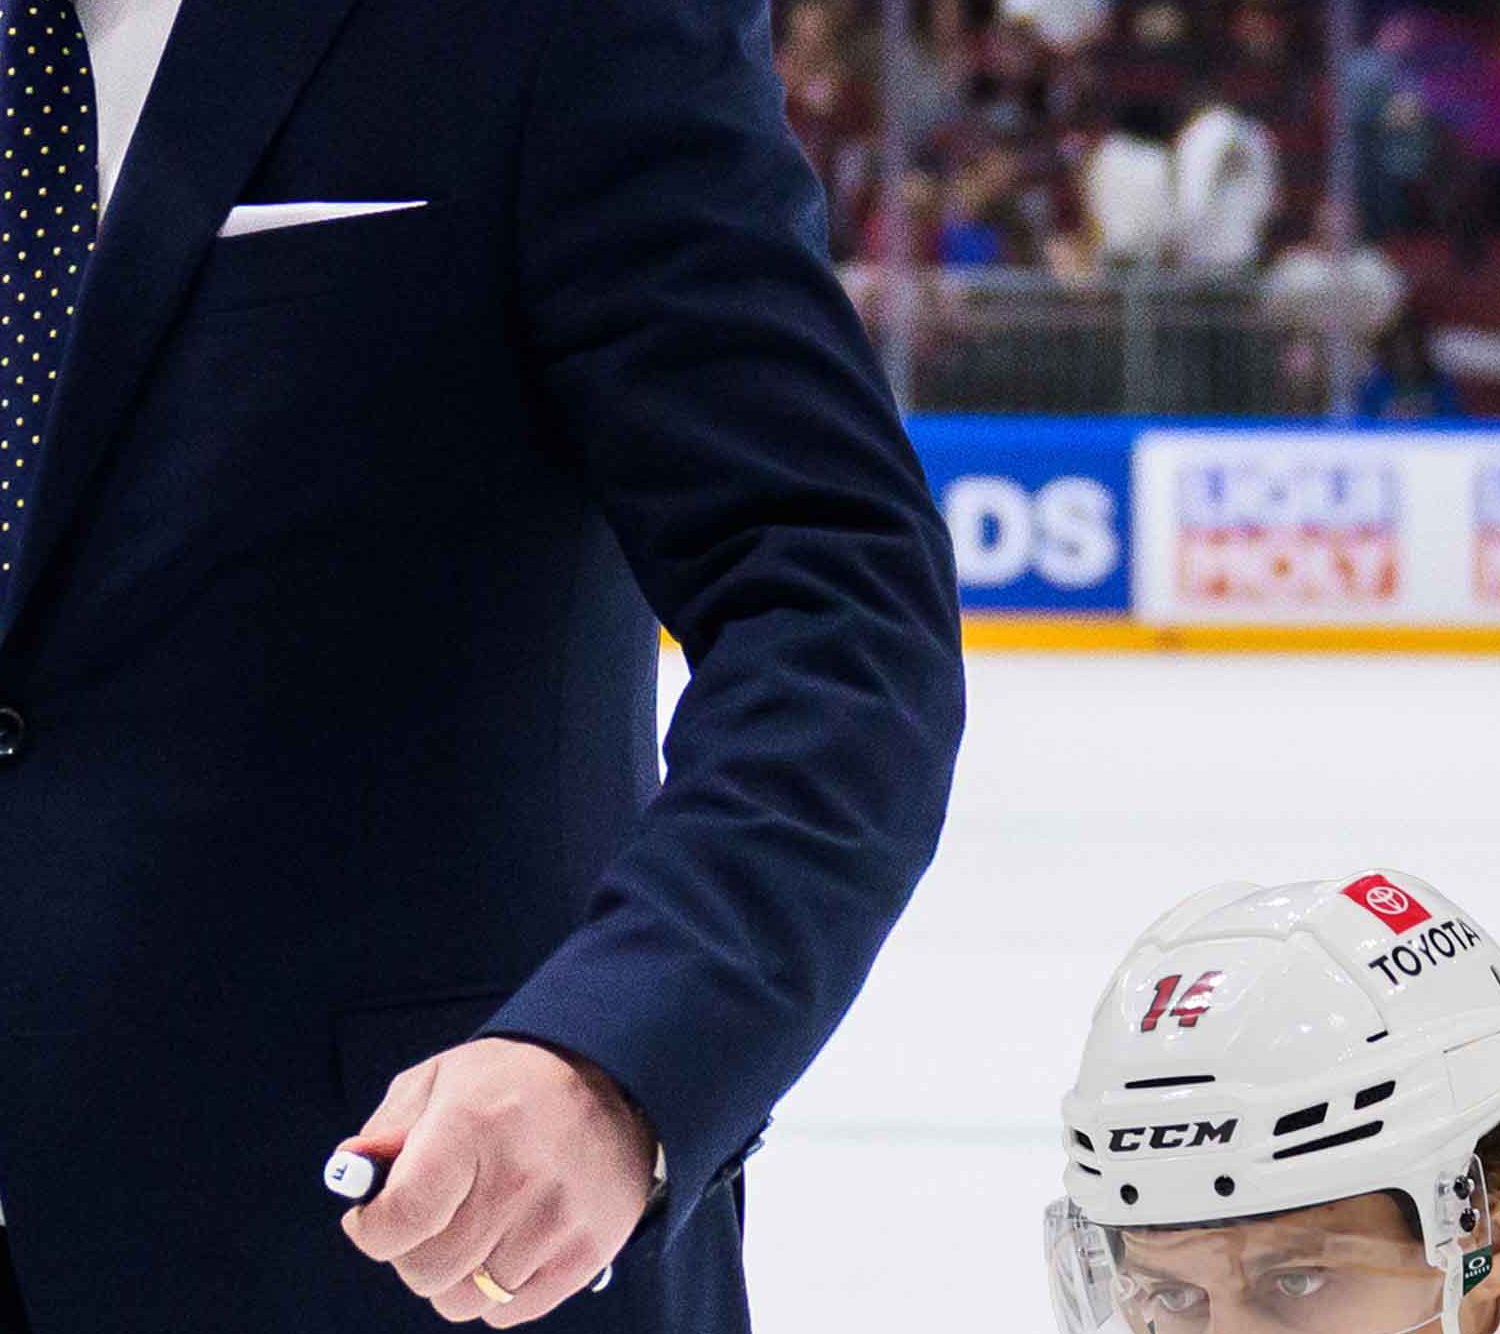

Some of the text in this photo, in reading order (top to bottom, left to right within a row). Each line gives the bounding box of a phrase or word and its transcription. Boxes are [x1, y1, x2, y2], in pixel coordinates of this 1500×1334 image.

[1369, 918, 1482, 986] TOYOTA
[1139, 969, 1224, 1033] 14
[1107, 1119, 1240, 1155] CCM
